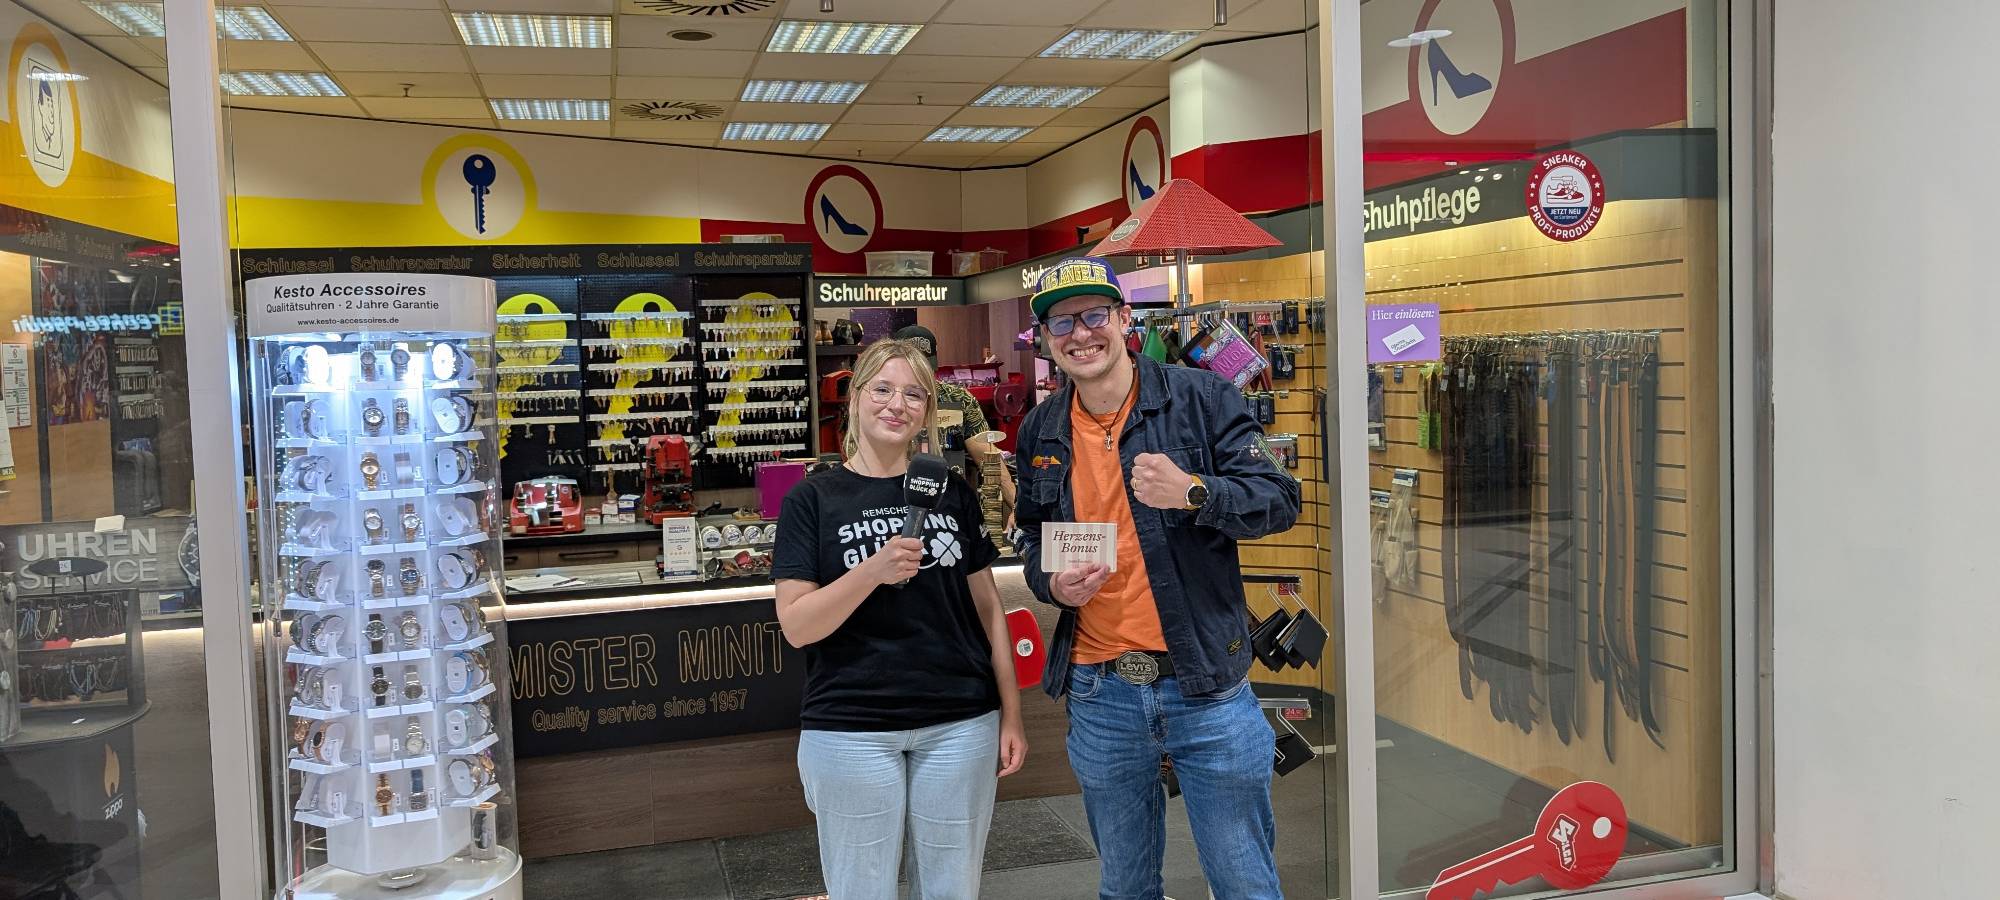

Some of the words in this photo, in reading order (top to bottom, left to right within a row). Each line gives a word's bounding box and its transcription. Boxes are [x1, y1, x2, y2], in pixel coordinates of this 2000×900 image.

[1543, 154, 1587, 169] SNEAKER
[1363, 186, 1480, 232] chuhpflege
[1530, 205, 1601, 239] PROFI-PRODUKTE
[350, 255, 473, 273] Schuhreparatur
[491, 252, 582, 269] Sicherheit
[694, 251, 804, 269] Schuhreparatur
[1059, 264, 1108, 285] ANGELES
[274, 284, 315, 299] Kesto
[320, 282, 427, 297] Accessoires
[820, 282, 948, 306] Schuhreparatur
[266, 300, 335, 314] Qualitätsuhren
[345, 301, 353, 309] 2
[356, 299, 389, 310] Jahre
[392, 300, 440, 310] Garantie
[1371, 309, 1393, 321] Hier
[1394, 308, 1435, 320] einlösen:
[297, 317, 399, 326] www.kesto-accessoires.de
[909, 477, 940, 489] SHOPPING
[862, 505, 909, 518] REMSCHE
[838, 513, 959, 544] SHOPING
[1053, 530, 1106, 542] Herzens-
[18, 528, 157, 561] UHREN
[1061, 542, 1098, 553] Bonus
[508, 633, 658, 699] MISTER
[678, 621, 785, 684] MINIT
[1120, 662, 1152, 672] Levi's
[532, 706, 590, 732] Quality
[597, 700, 657, 725] service
[663, 695, 706, 718] since
[709, 688, 748, 713] 1957
